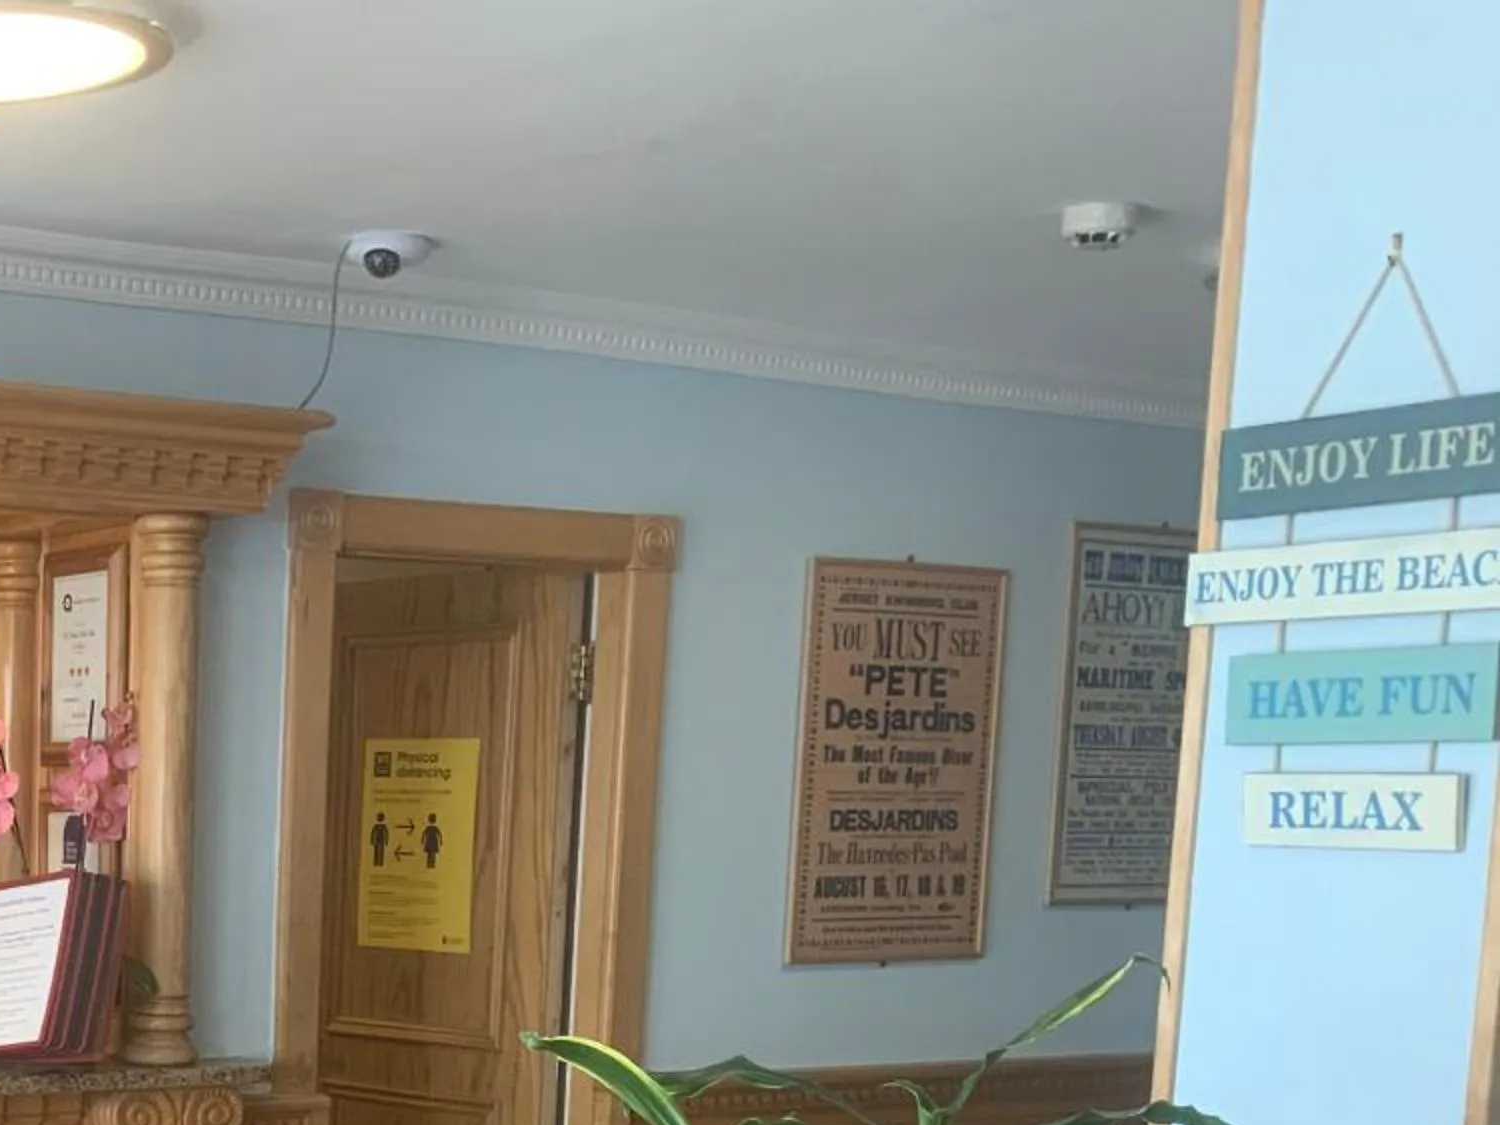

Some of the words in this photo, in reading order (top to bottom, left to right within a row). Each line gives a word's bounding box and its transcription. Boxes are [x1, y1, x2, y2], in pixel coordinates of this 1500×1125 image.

[1238, 436, 1379, 493] ENJOY
[1387, 421, 1496, 476] LIFE
[1194, 564, 1303, 605] ENJOY
[1311, 559, 1385, 597] THE
[1396, 549, 1500, 592] BEAC
[831, 621, 867, 652] YOU
[873, 618, 946, 663] MUST
[949, 628, 982, 658] SEE
[824, 697, 977, 740] Desjardins
[1247, 676, 1364, 721] HAVE
[1378, 673, 1477, 717] FUN
[829, 809, 959, 833] DESJARDINS
[1269, 790, 1424, 832] RELAX
[818, 841, 842, 864] The
[814, 875, 867, 898] AUGUST
